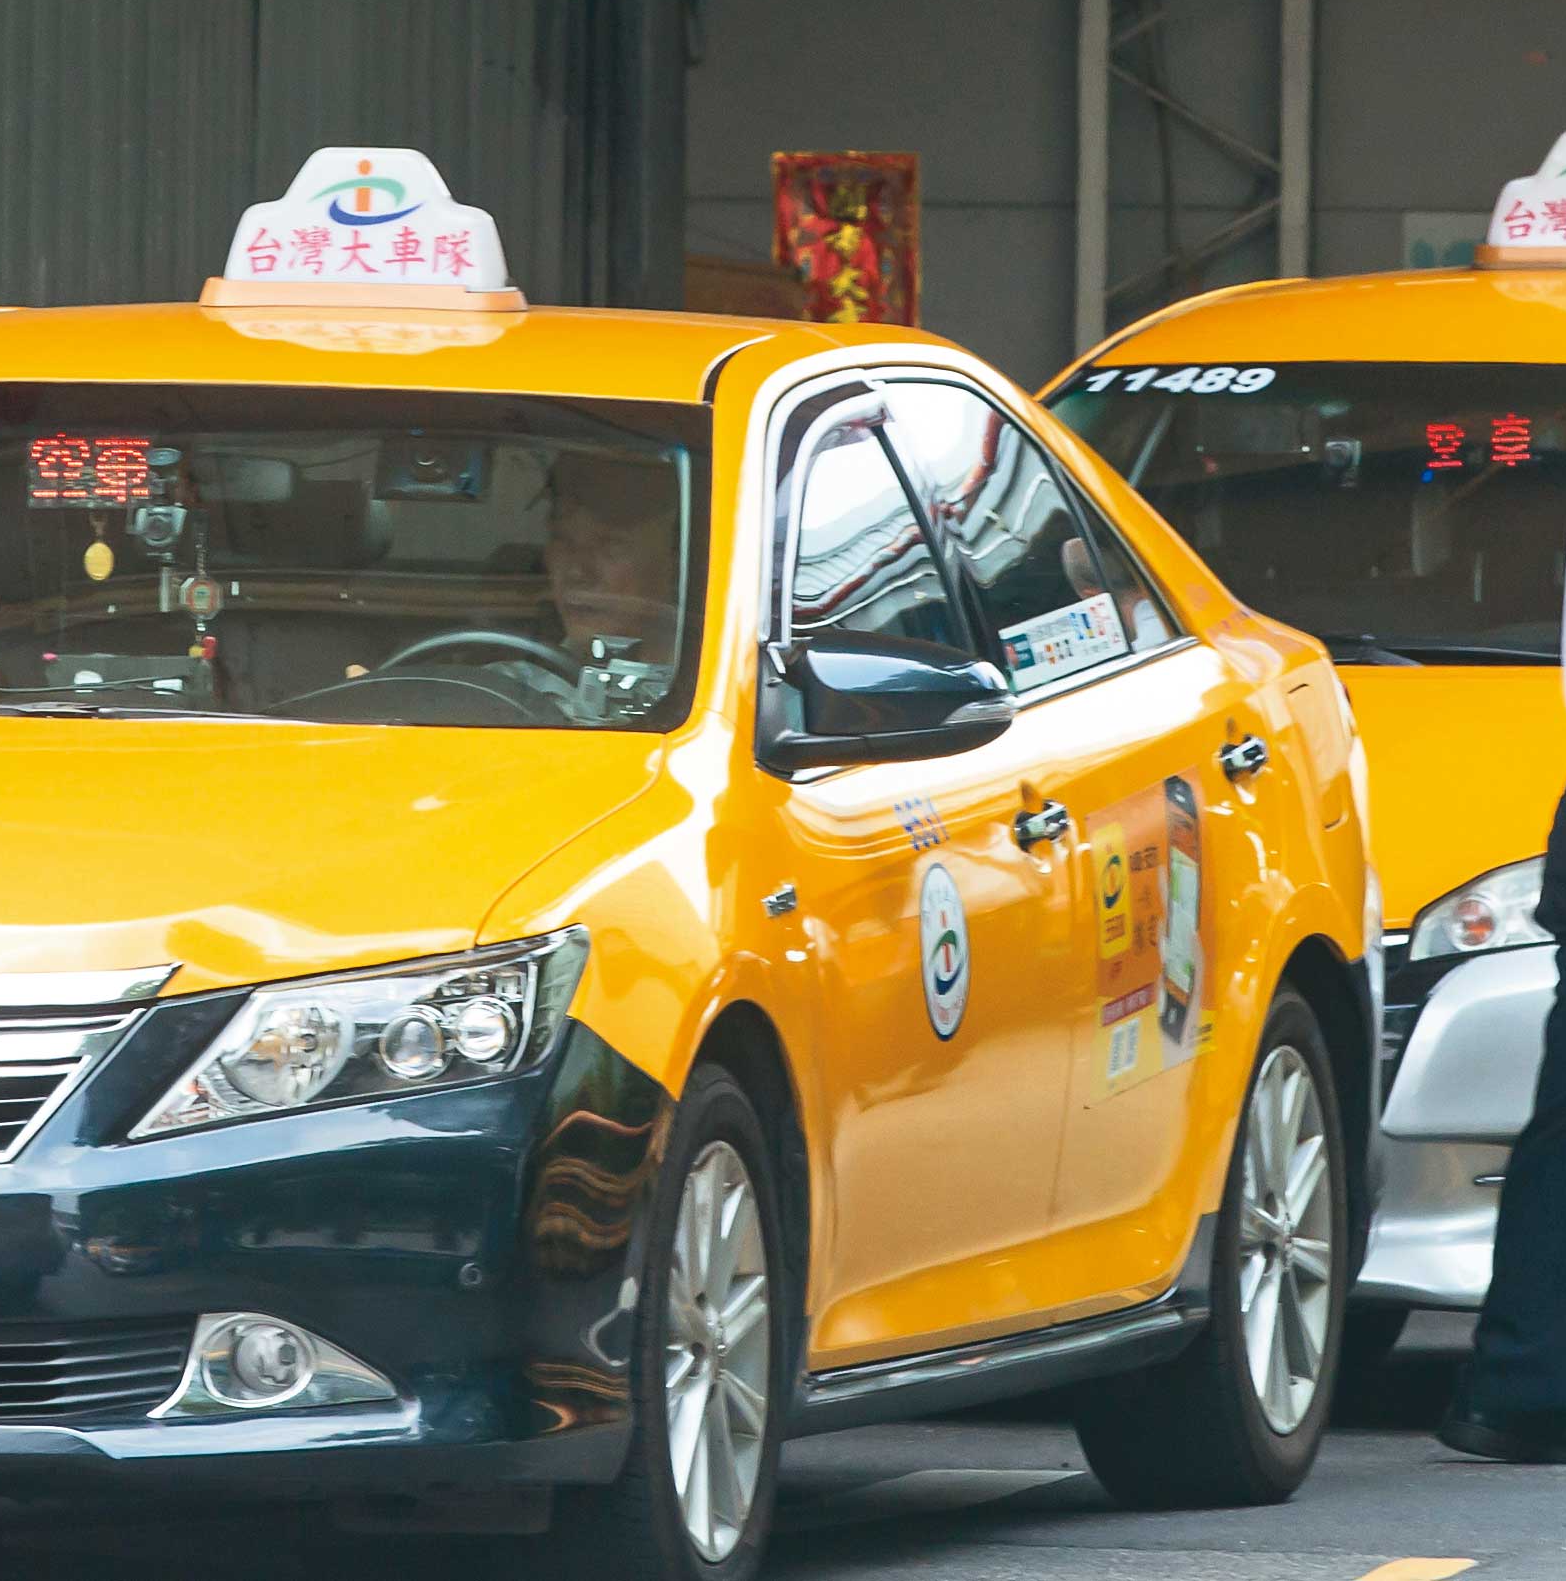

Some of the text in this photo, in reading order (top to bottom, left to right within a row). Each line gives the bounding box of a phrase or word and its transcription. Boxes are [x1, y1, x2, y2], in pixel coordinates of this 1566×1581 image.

[246, 225, 475, 277] 台灣大車隊
[1084, 367, 1277, 394] 11489
[31, 432, 150, 502] 空車
